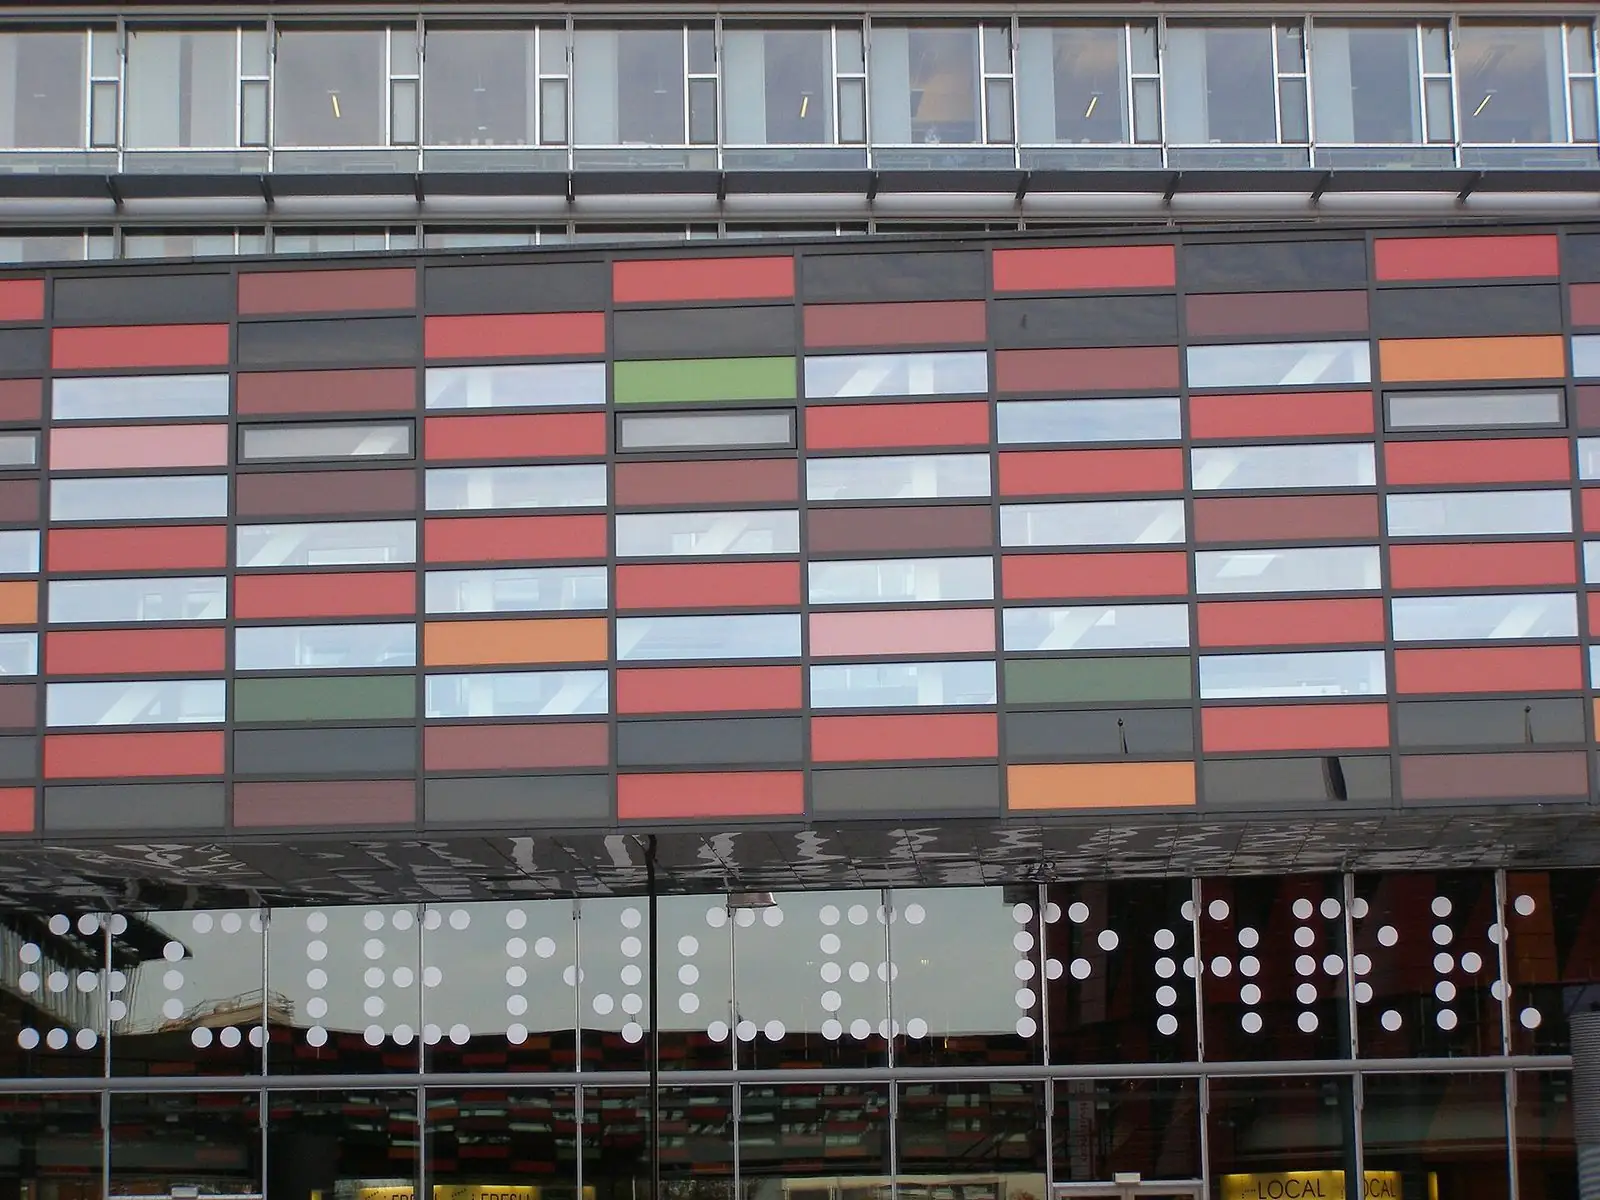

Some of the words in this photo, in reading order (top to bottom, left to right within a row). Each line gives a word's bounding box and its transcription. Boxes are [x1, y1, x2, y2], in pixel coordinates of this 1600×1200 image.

[17, 903, 929, 1050] SCIENCE
[1012, 895, 1542, 1039] PARK
[1258, 1178, 1326, 1199] LOCAL
